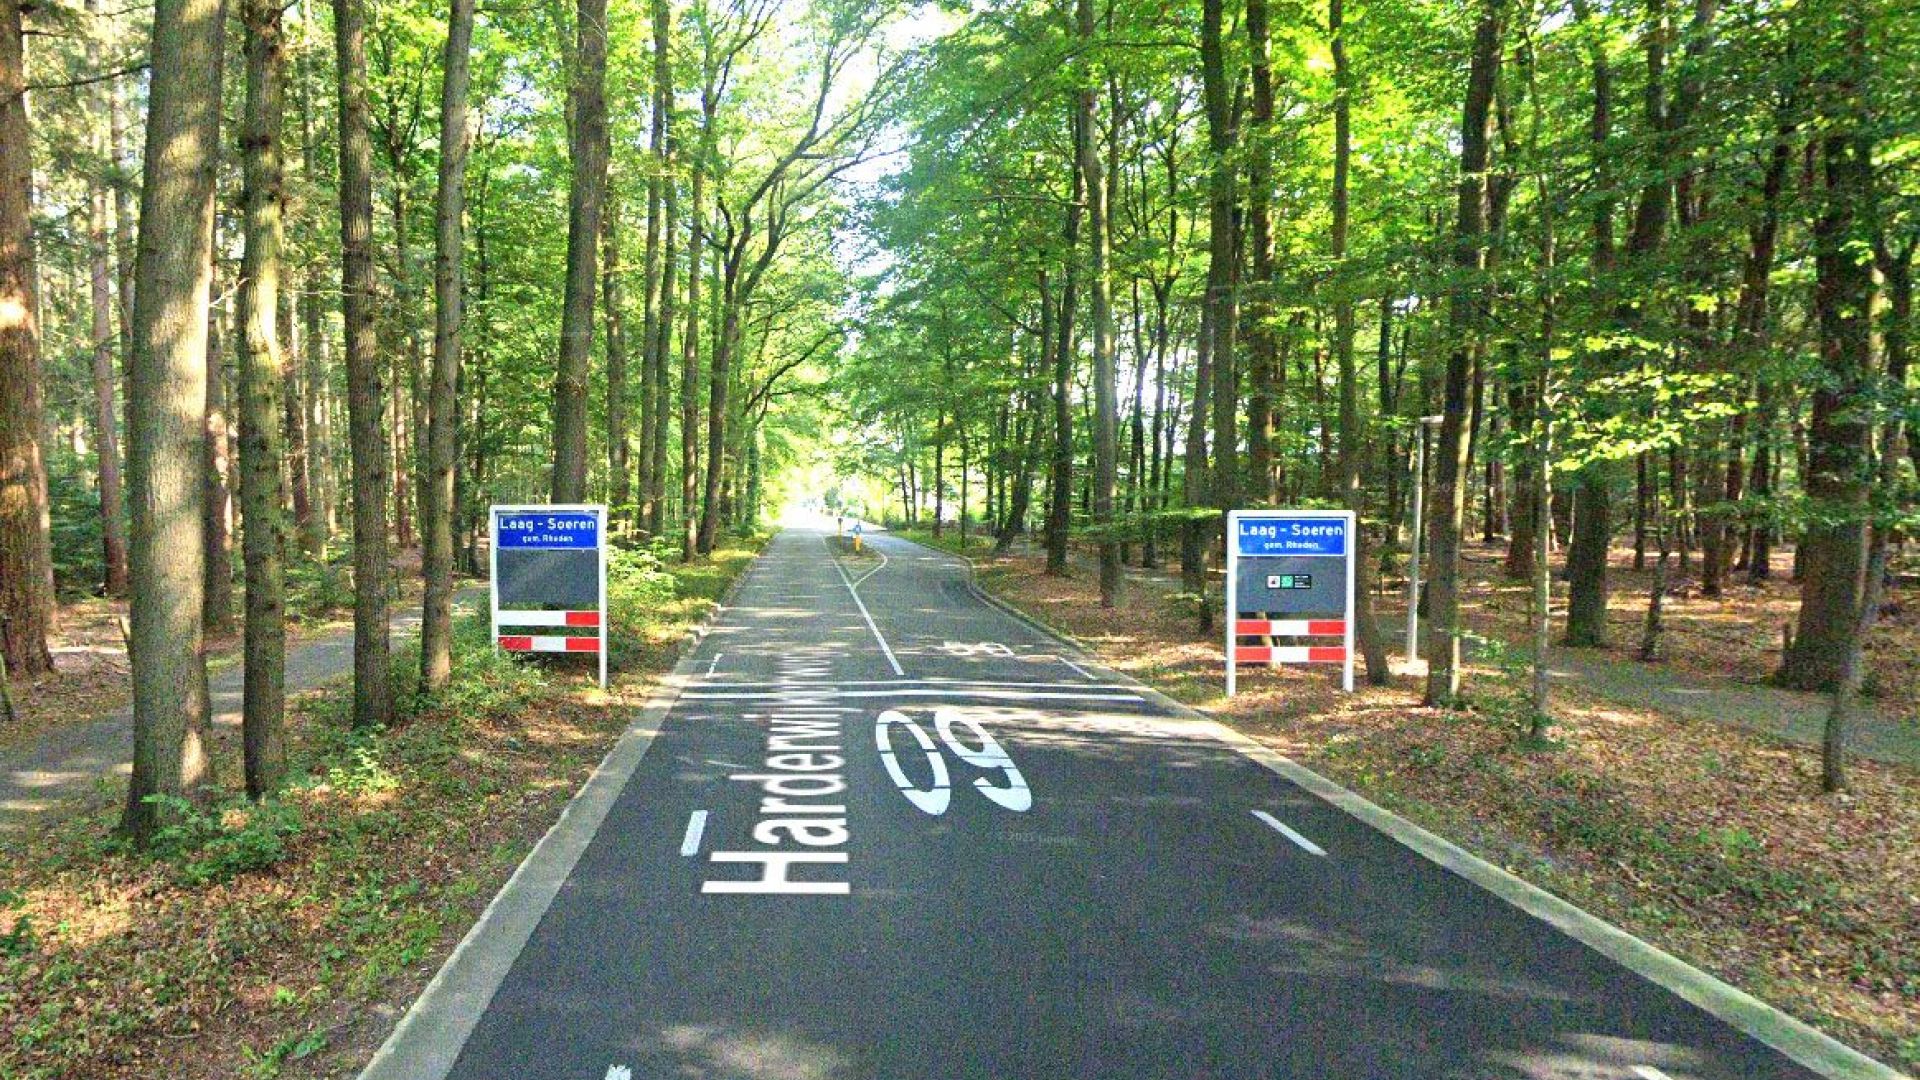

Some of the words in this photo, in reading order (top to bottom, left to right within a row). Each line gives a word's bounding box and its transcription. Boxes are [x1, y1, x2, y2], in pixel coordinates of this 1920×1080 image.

[500, 517, 534, 531] Laag
[547, 517, 595, 529] Soeren
[1240, 524, 1276, 538] Laag
[1292, 524, 1343, 536] Soeren
[1286, 541, 1319, 549] Rheden
